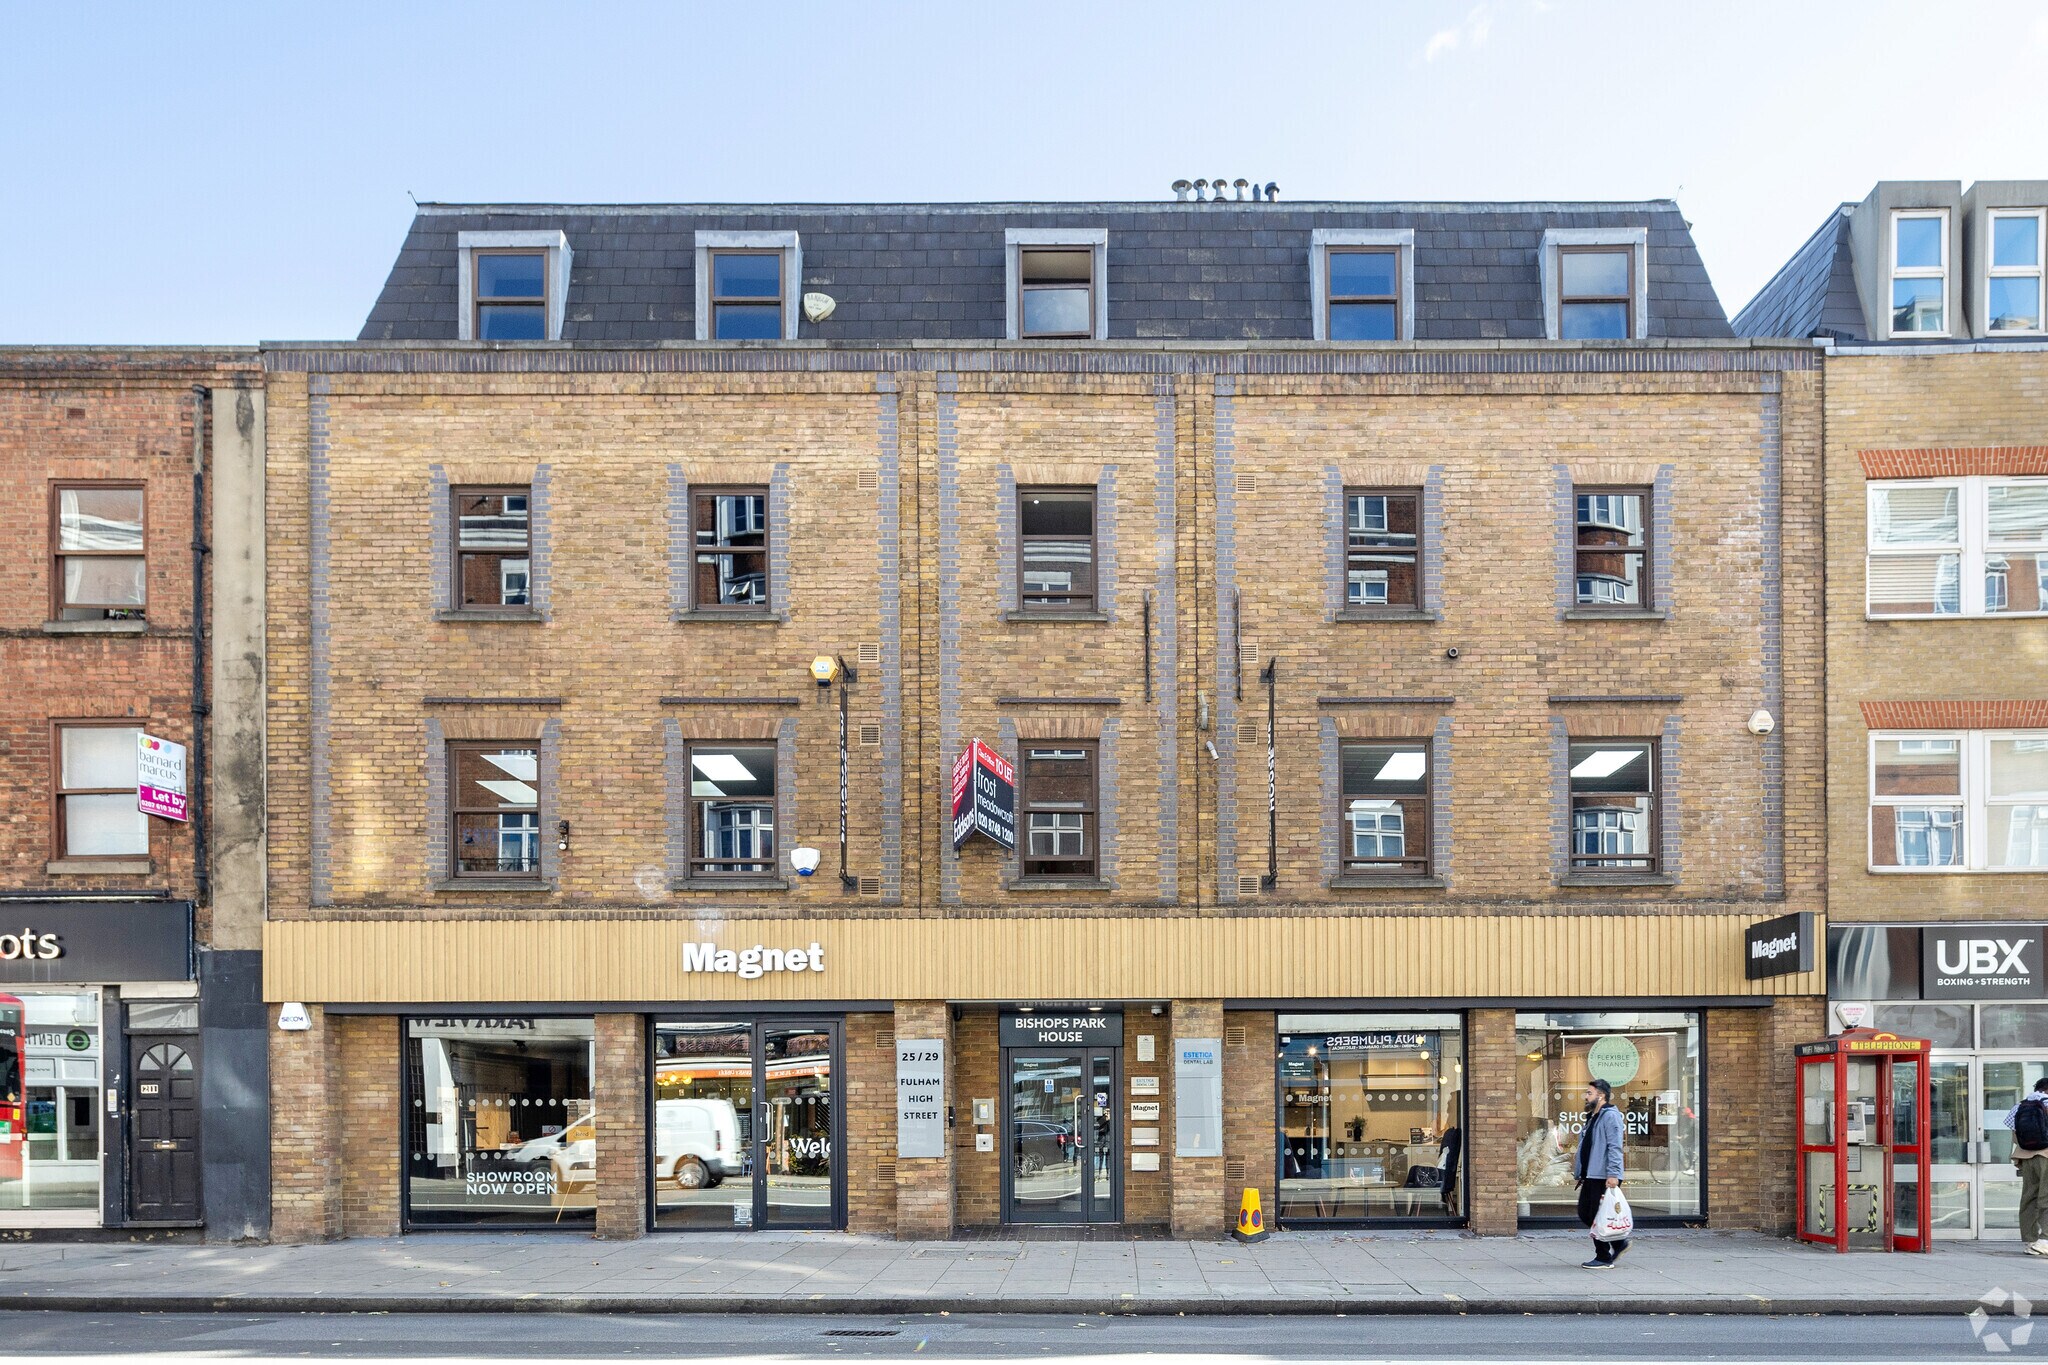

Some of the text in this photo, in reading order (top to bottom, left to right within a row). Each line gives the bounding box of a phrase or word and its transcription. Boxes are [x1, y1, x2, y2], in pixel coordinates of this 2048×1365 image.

[140, 749, 181, 771] barnard
[140, 763, 177, 780] marcus
[995, 758, 1013, 782] TO LET
[977, 767, 997, 798] frost
[152, 790, 185, 809] Let by
[977, 793, 1014, 825] meadowcroft
[978, 811, 988, 829] 020
[0, 927, 60, 960] ots
[1751, 932, 1797, 959] Magnet
[682, 942, 825, 979] Magnet
[1936, 939, 2030, 975] UBX
[1937, 978, 1974, 986] BOXING
[1980, 977, 2030, 985] STRENGTH
[1015, 1018, 1106, 1029] BISHOPS PARK
[1038, 1031, 1083, 1042] HOUSE
[900, 1078, 940, 1086] FULHAM
[908, 1095, 933, 1103] HIGH
[1298, 1094, 1333, 1104] Magnet
[904, 1112, 938, 1120] STREET
[466, 1171, 557, 1183] SHOWROOM
[466, 1183, 558, 1195] NOW OPEN
